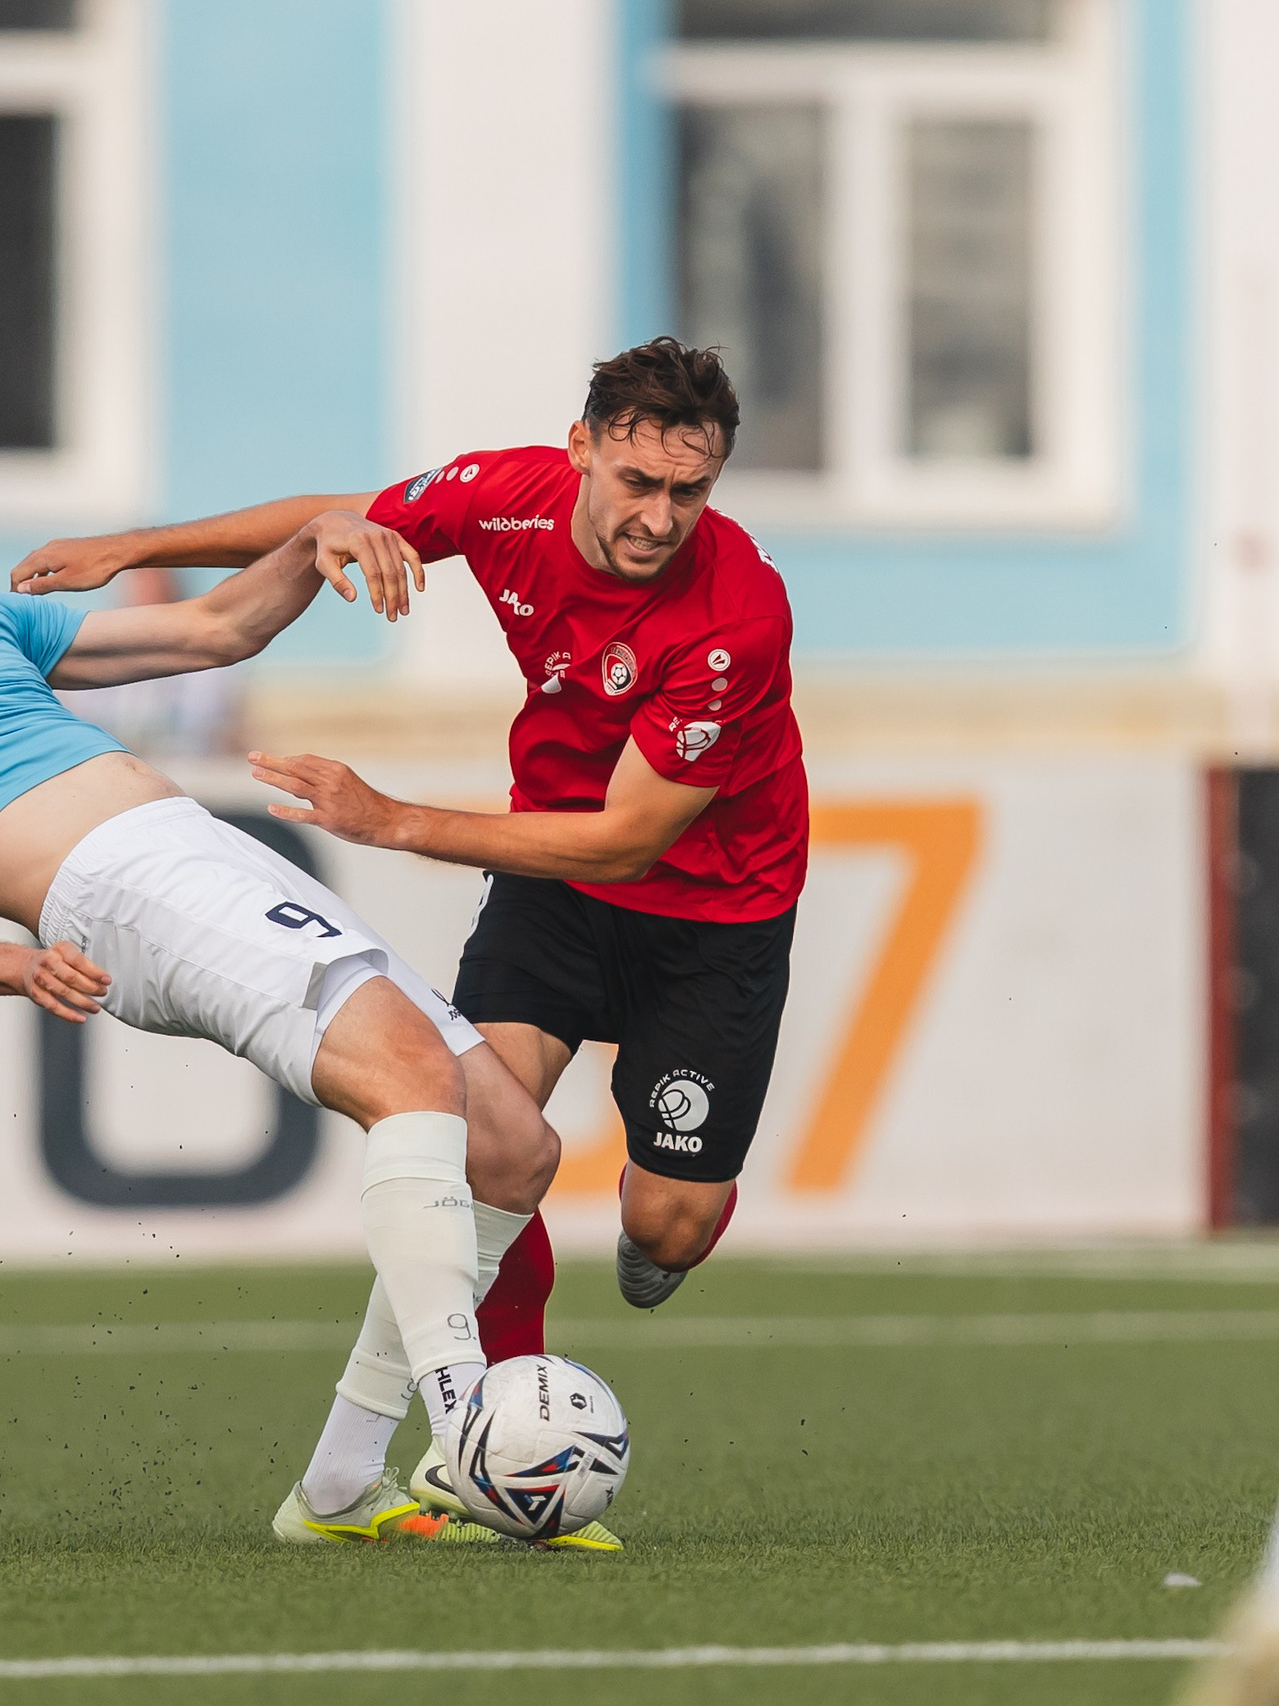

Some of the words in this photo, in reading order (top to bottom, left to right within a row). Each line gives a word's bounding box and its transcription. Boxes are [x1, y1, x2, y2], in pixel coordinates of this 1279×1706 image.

[478, 515, 555, 531] wildberies
[265, 901, 342, 937] 9
[649, 1074, 671, 1107] REPIK
[672, 1069, 715, 1091] ACTIVE
[654, 1132, 703, 1153] JAKO
[536, 1364, 550, 1421] DEMIX
